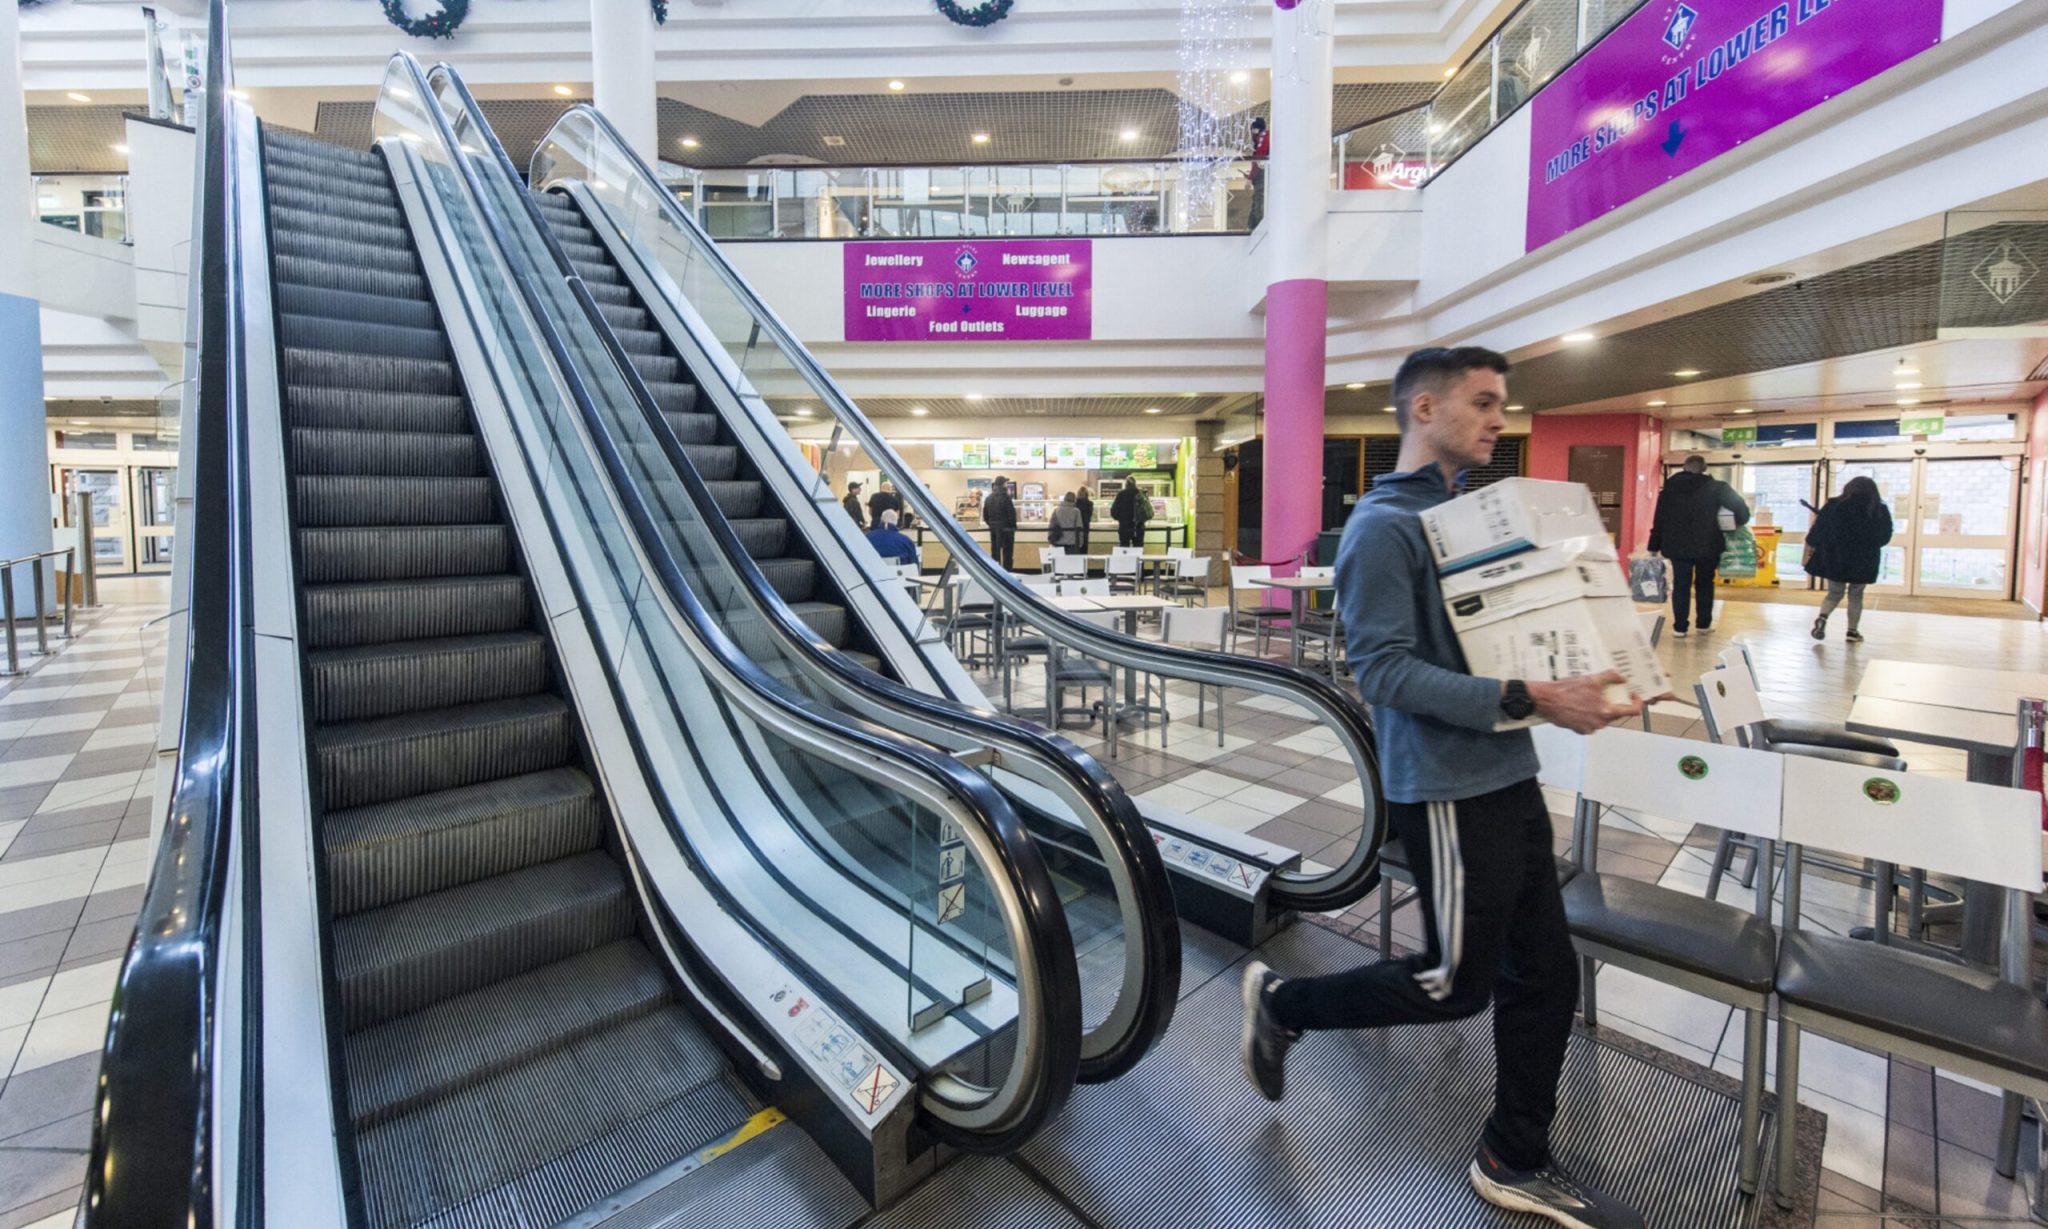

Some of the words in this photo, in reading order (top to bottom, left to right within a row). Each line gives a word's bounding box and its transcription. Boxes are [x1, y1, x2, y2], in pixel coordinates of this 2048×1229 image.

[1546, 136, 1591, 184] MORE
[1595, 90, 1659, 153] SHOPS
[1662, 66, 1692, 111] AT
[1695, 1, 1789, 91] LOWER
[865, 253, 923, 267] Jewellery
[1002, 252, 1070, 266] Newsagent
[860, 282, 902, 298] MORE
[905, 282, 954, 298] SHOPS
[958, 281, 974, 298] AT
[979, 281, 1029, 298] LOWER
[1032, 281, 1074, 298] LEVEL
[866, 304, 916, 318] Lingerie
[1015, 304, 1068, 318] Luggage
[929, 320, 958, 333] Food
[960, 320, 1005, 333] Outlets
